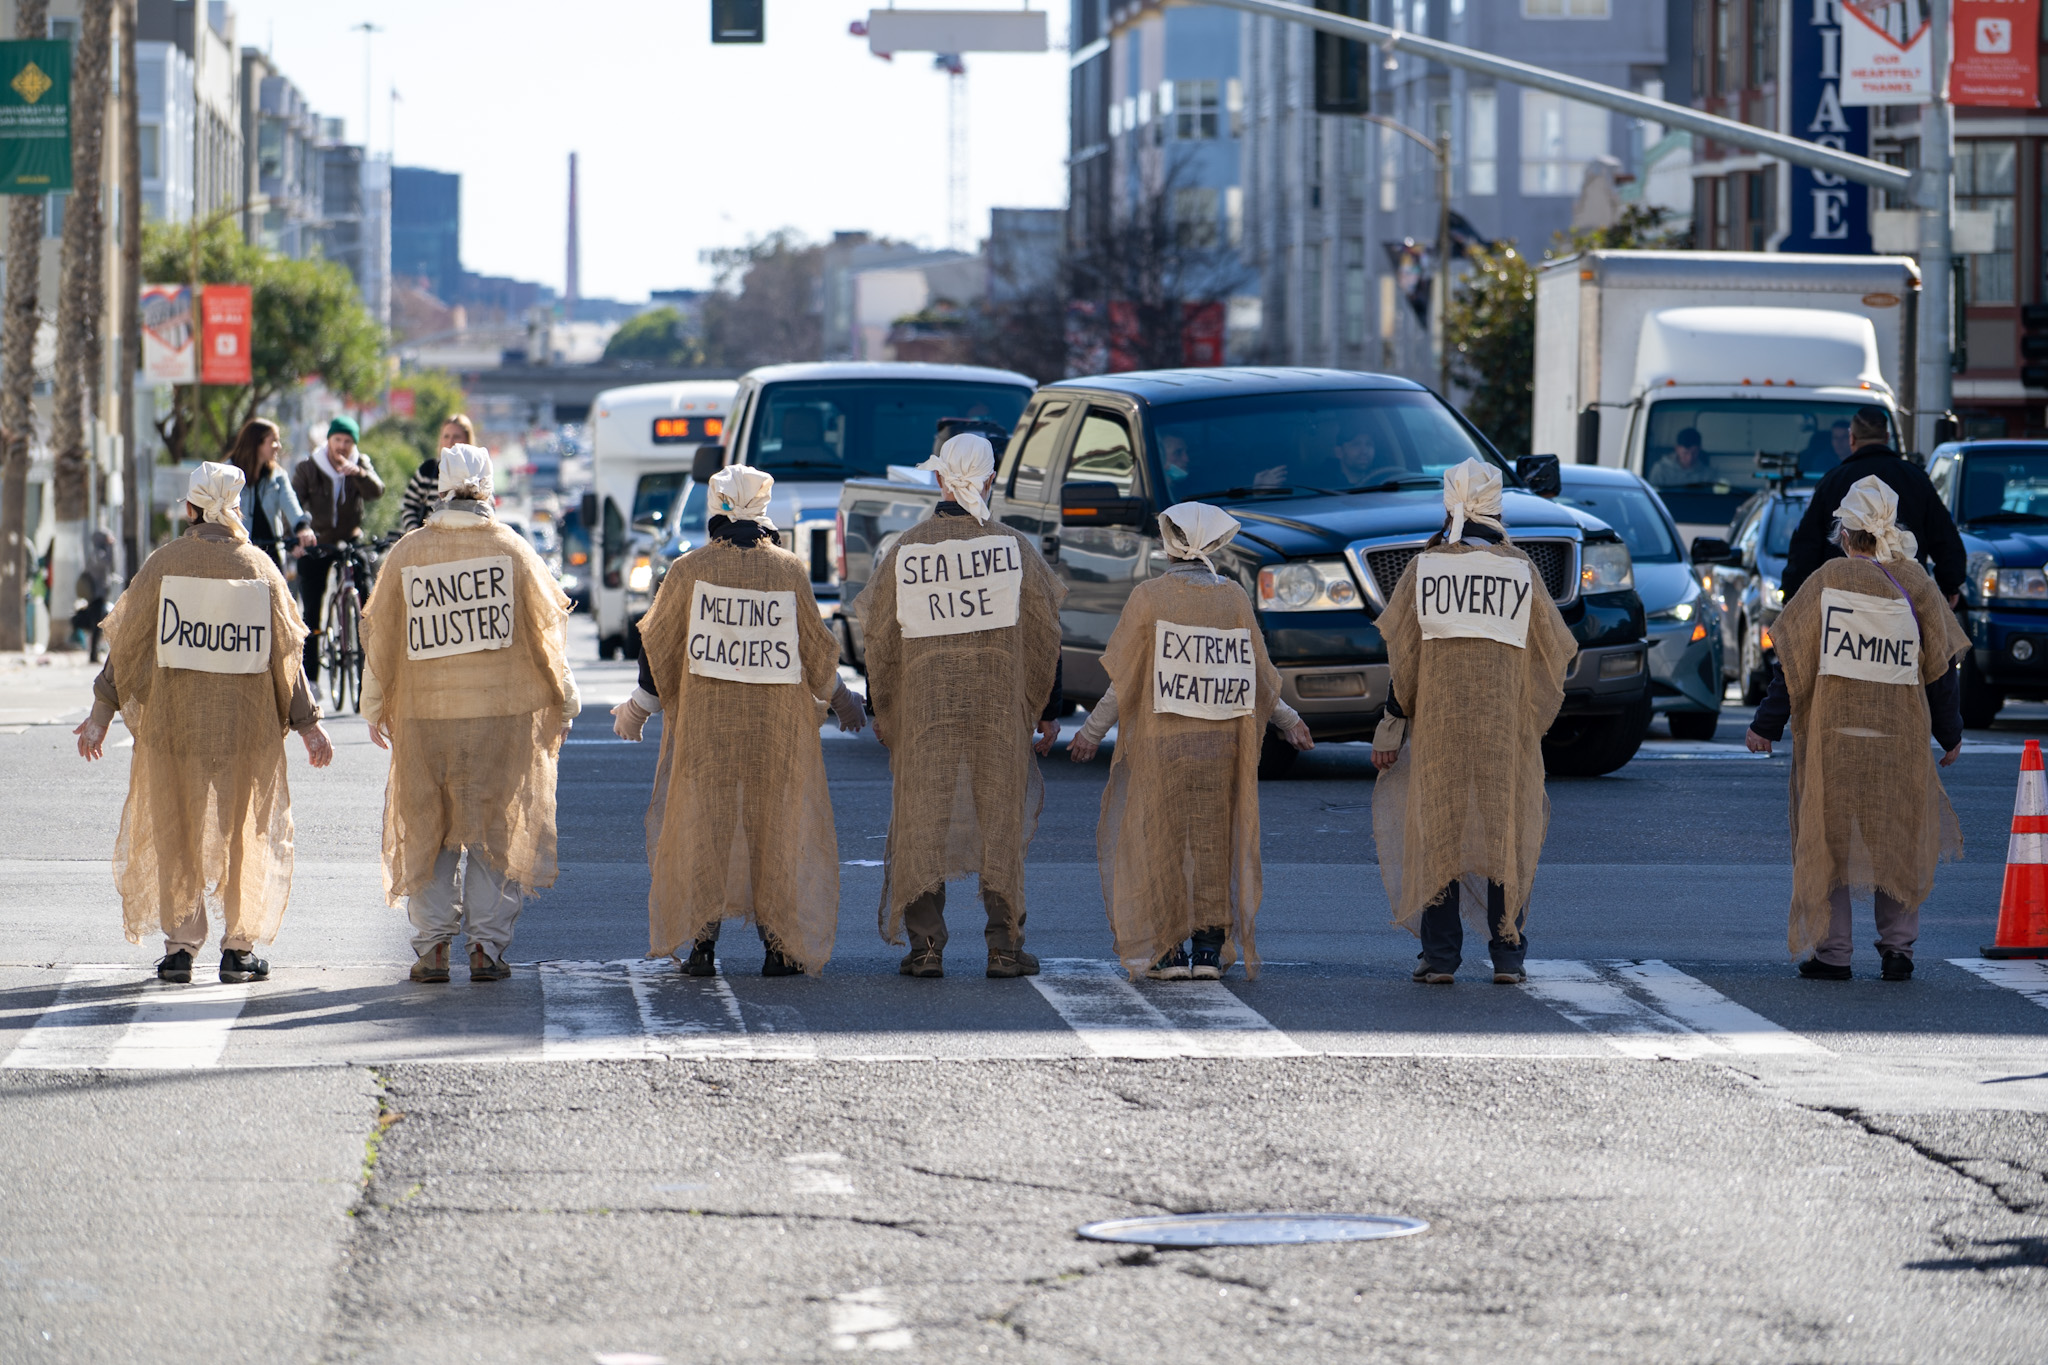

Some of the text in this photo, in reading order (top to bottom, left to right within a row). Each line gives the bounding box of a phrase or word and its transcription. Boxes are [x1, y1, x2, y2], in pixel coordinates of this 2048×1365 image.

[1851, 68, 1921, 79] HEARTFELT
[1873, 55, 1900, 64] OUR
[1862, 82, 1912, 93] THANKS
[903, 547, 1019, 585] SEA LEVEL
[411, 567, 507, 608] CANCER
[928, 588, 994, 621] RISE
[1422, 574, 1530, 620] POVERTY
[161, 598, 265, 652] DROUGHT
[409, 603, 511, 652] CLUSTERS
[700, 594, 782, 627] MELTING
[690, 633, 791, 669] GLACIERS
[1163, 631, 1251, 665] EXTREME
[1824, 606, 1914, 667] FAMINE
[1158, 671, 1250, 706] WEATHER
